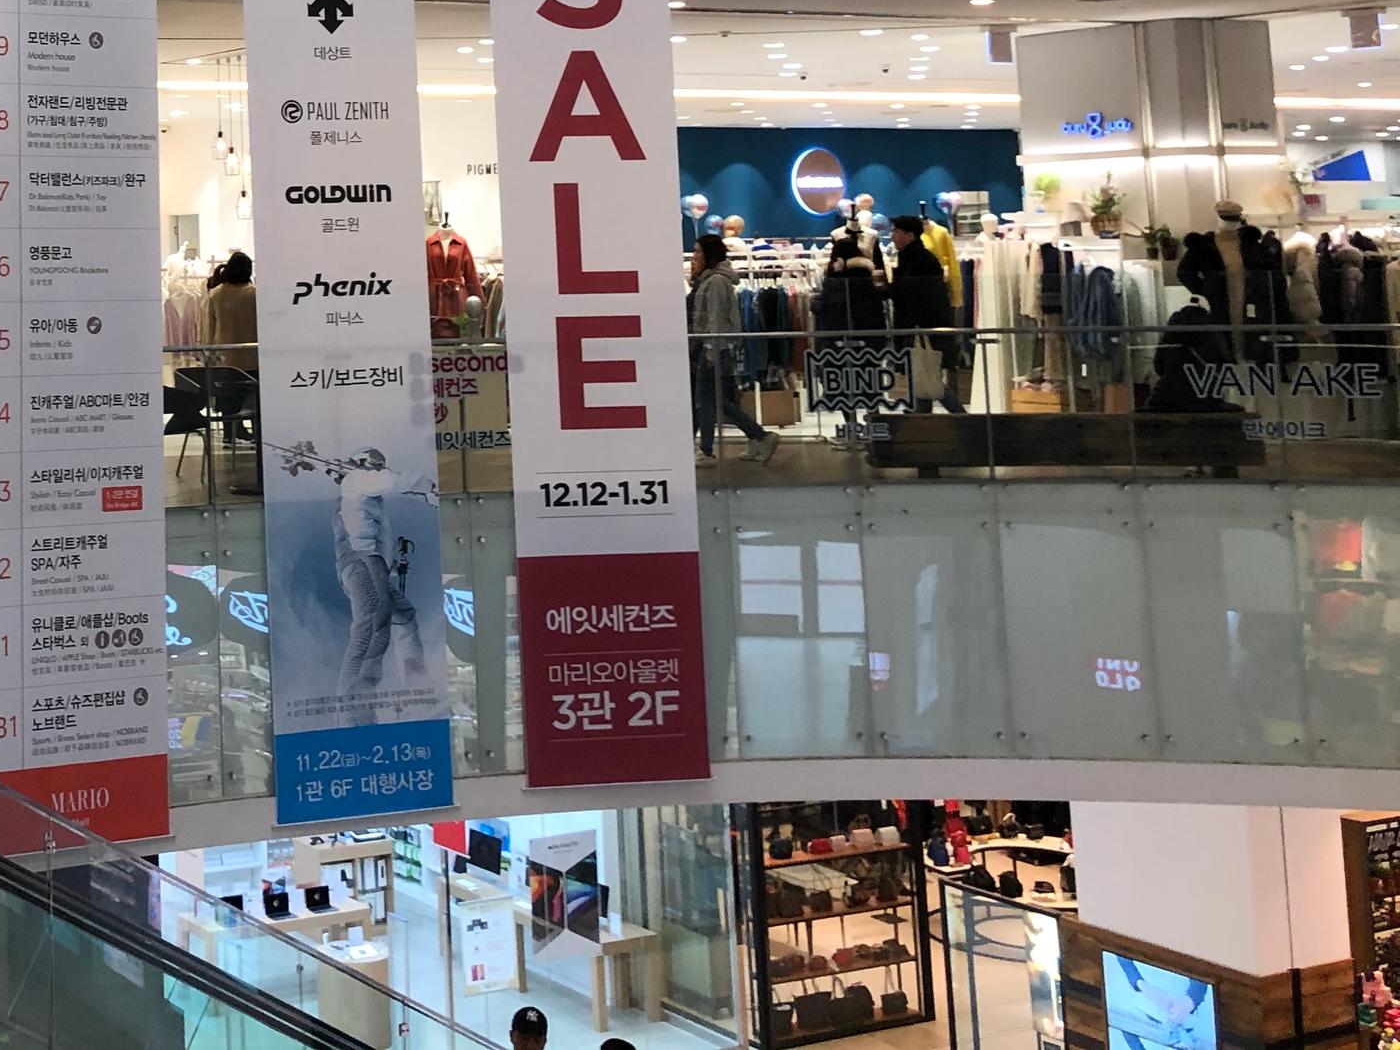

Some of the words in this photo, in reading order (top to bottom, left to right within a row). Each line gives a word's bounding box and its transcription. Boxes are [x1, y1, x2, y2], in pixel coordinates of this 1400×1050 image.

[28, 32, 81, 46] 모던하우스
[314, 46, 352, 60] 데상트
[27, 95, 128, 111] 전자랜드/리빙전문관
[307, 102, 341, 121] PAUL
[345, 101, 390, 121] ZENITH
[309, 130, 363, 146] 폴제니스
[321, 217, 360, 233] 골드윈
[29, 246, 73, 260] 영풍문고
[292, 271, 393, 305] phenix
[29, 318, 78, 333] 유아/아동
[326, 311, 364, 325] 피닉스
[290, 365, 404, 390] 스키/보드장비
[825, 368, 895, 393] BIND
[1184, 363, 1277, 398] VAN
[1291, 363, 1383, 398] AKE
[835, 422, 892, 441] 바인드
[30, 465, 144, 484] 스타일리쉬/이지캐주얼
[539, 480, 669, 508] 12.12-1.31
[31, 534, 108, 552] 스트리트캐주얼
[31, 555, 81, 571] SPA/자주
[546, 603, 677, 635] 에잇세컨즈
[1, 635, 9, 657] 1
[32, 635, 76, 651] 스타벅스
[549, 658, 679, 687] 마리오아울렛
[32, 690, 125, 712] 스포츠/슈즈편집샵
[552, 690, 616, 731] 3관
[627, 689, 681, 728] 2F
[32, 714, 77, 731] 노브랜드
[296, 781, 323, 802] 1관
[330, 778, 353, 798] 6F
[361, 769, 434, 795] 대행사장
[51, 787, 110, 813] MARIO
